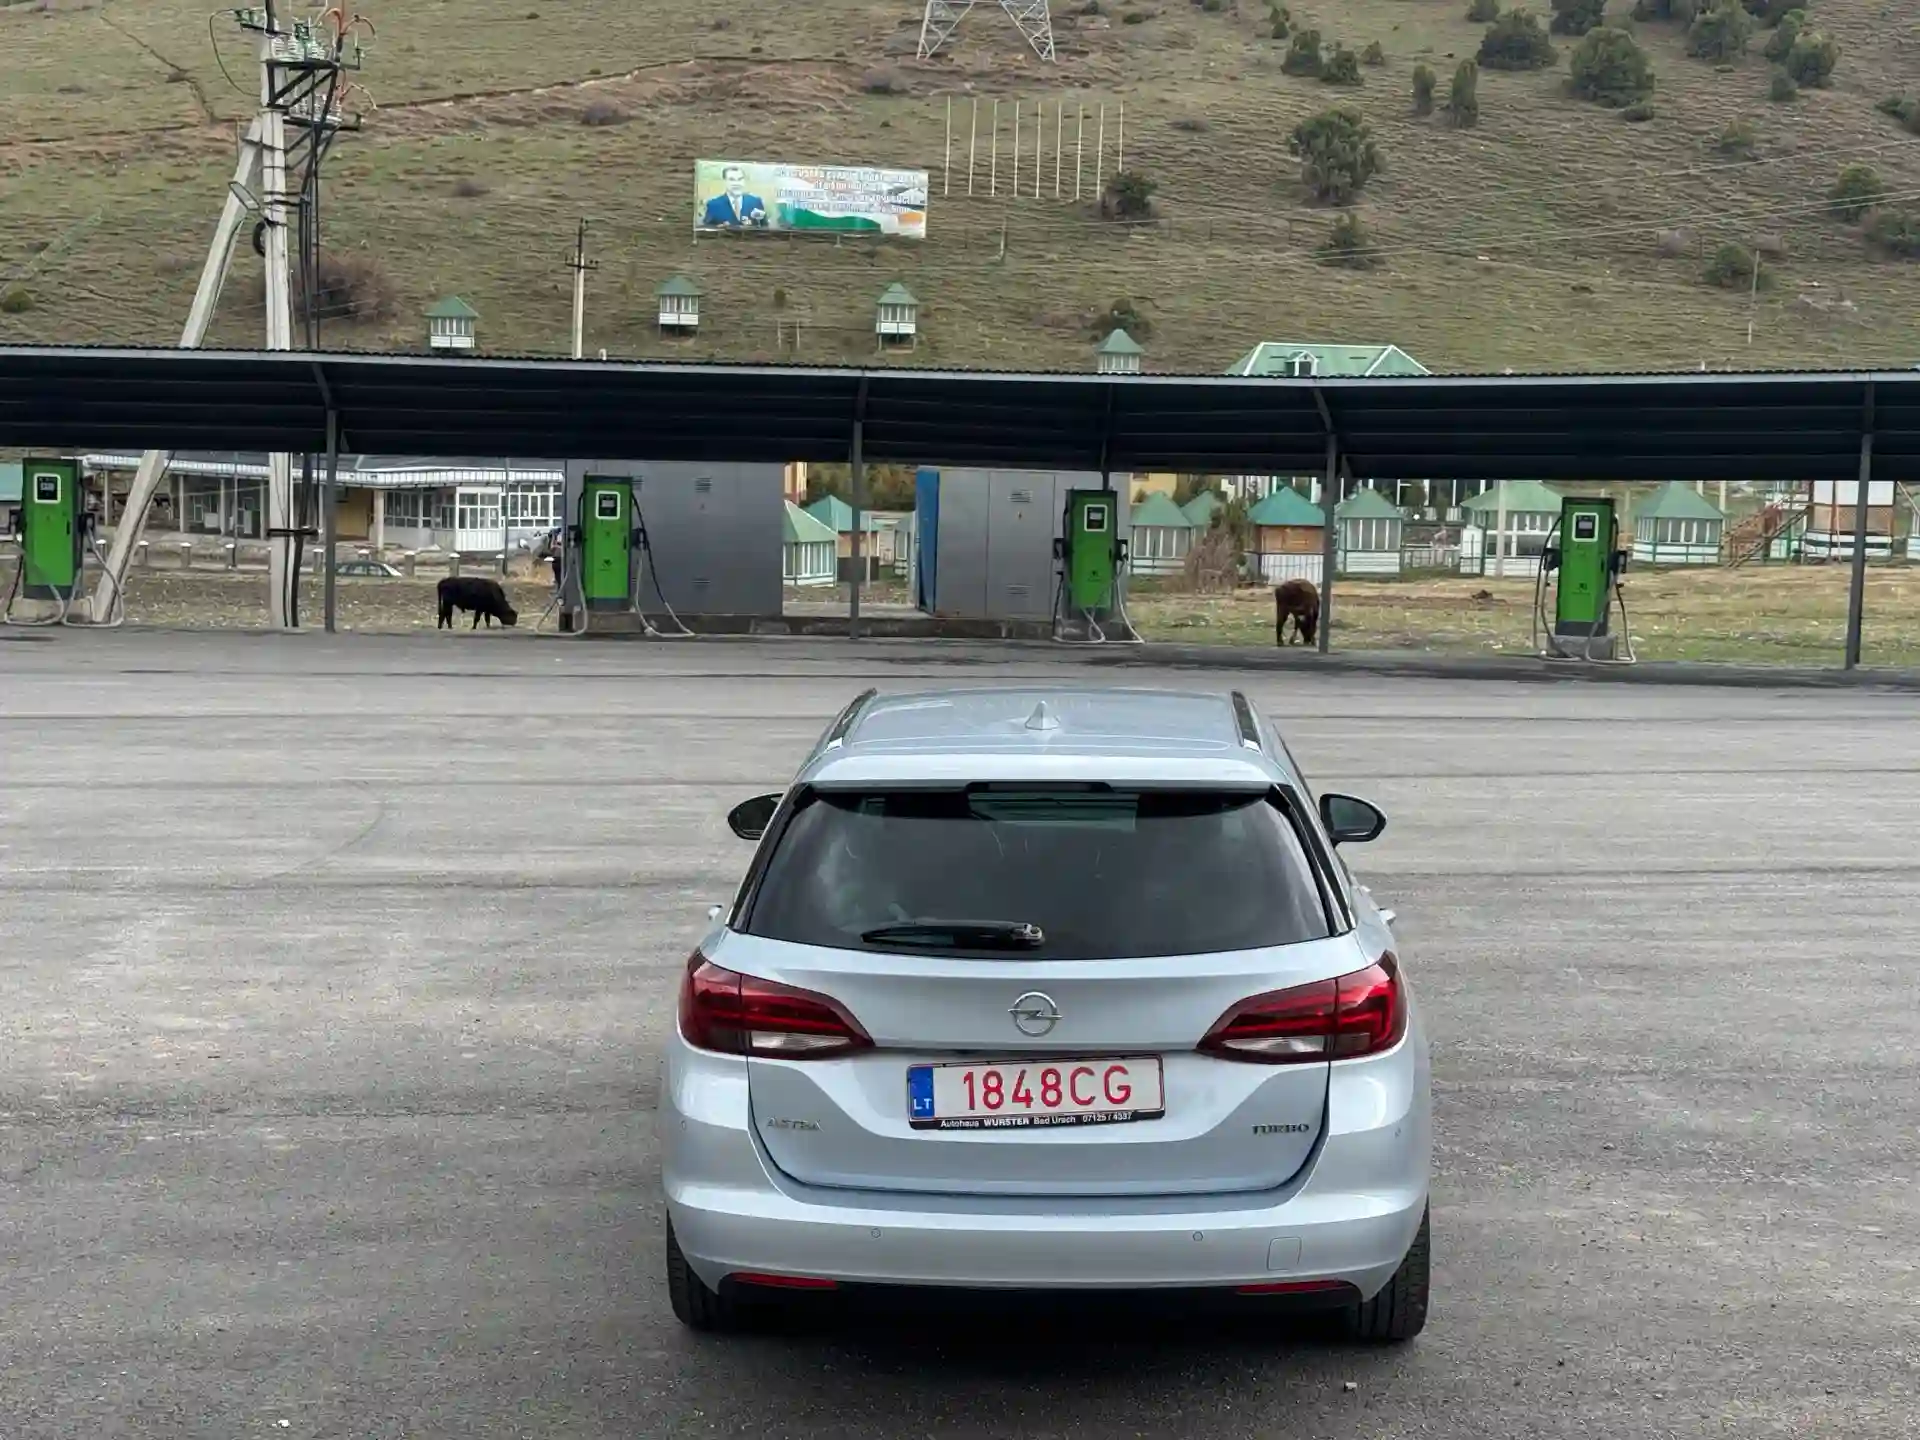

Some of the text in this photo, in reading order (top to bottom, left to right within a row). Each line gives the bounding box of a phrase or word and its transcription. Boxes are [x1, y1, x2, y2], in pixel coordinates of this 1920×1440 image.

[963, 1065, 1132, 1110] 1848CG
[913, 1098, 931, 1110] LT
[940, 1119, 980, 1128] Autohaus
[983, 1117, 1030, 1126] WURSTER
[1034, 1115, 1050, 1125] Bad
[1251, 1123, 1310, 1135] TURBO
